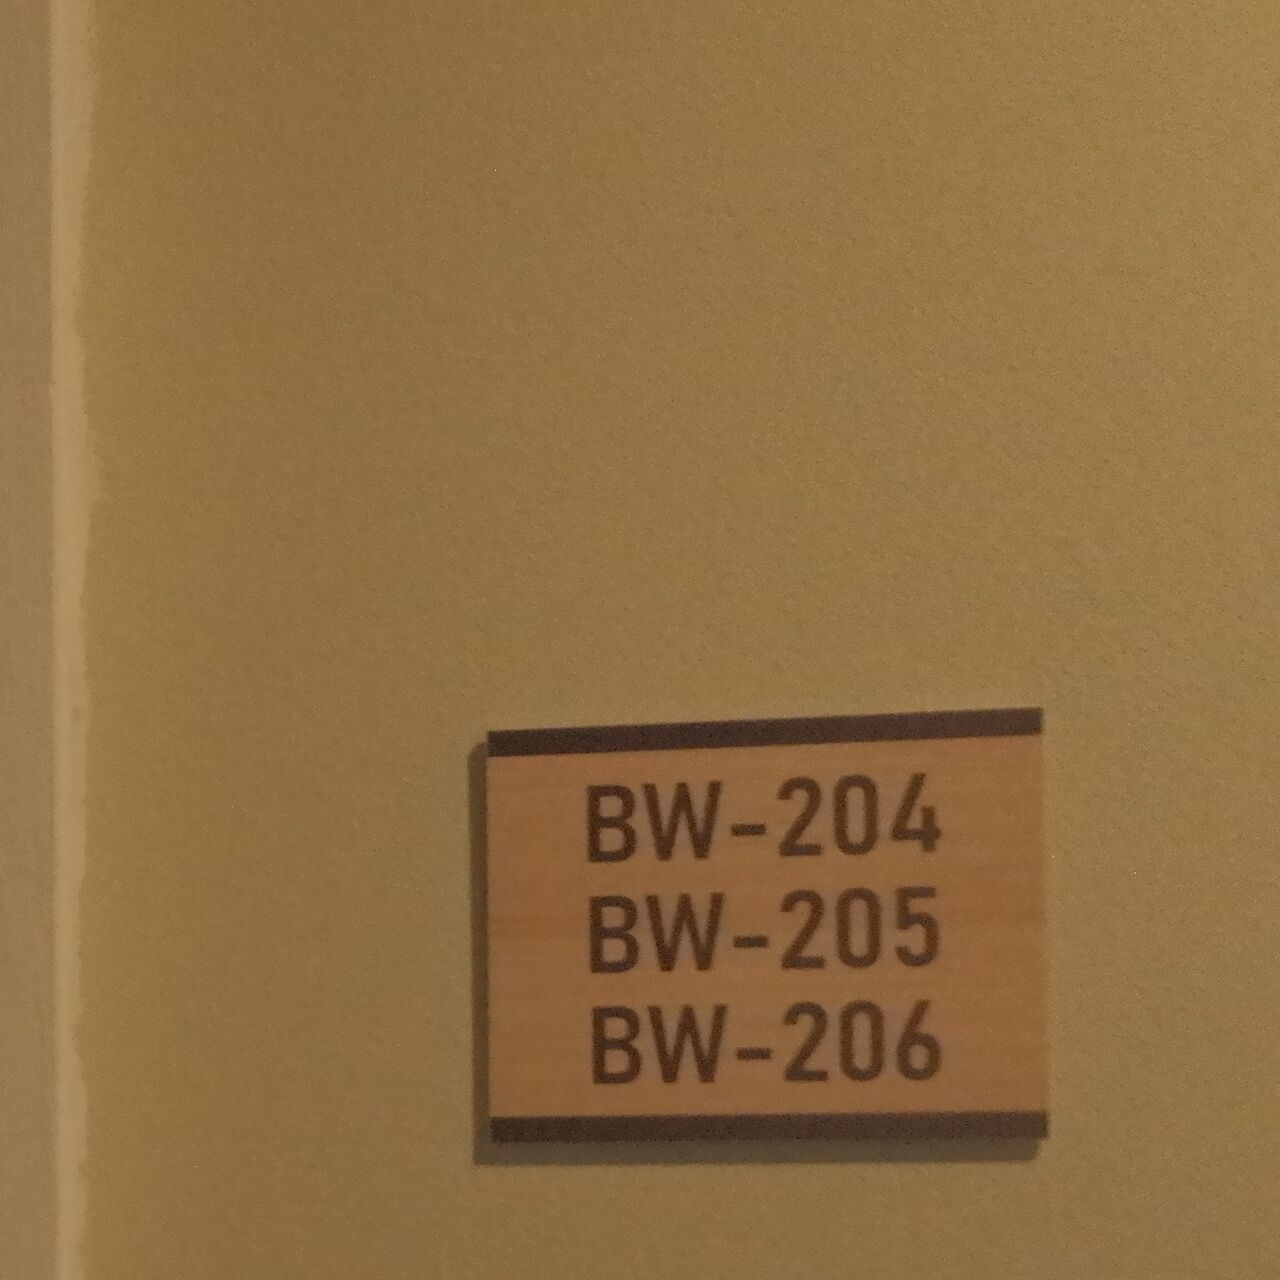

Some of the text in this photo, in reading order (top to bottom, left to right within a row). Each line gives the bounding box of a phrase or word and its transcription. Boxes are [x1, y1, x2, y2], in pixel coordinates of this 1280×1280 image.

[585, 773, 942, 863] BW-204
[587, 885, 942, 975] BW-205
[590, 999, 943, 1085] BW-206
